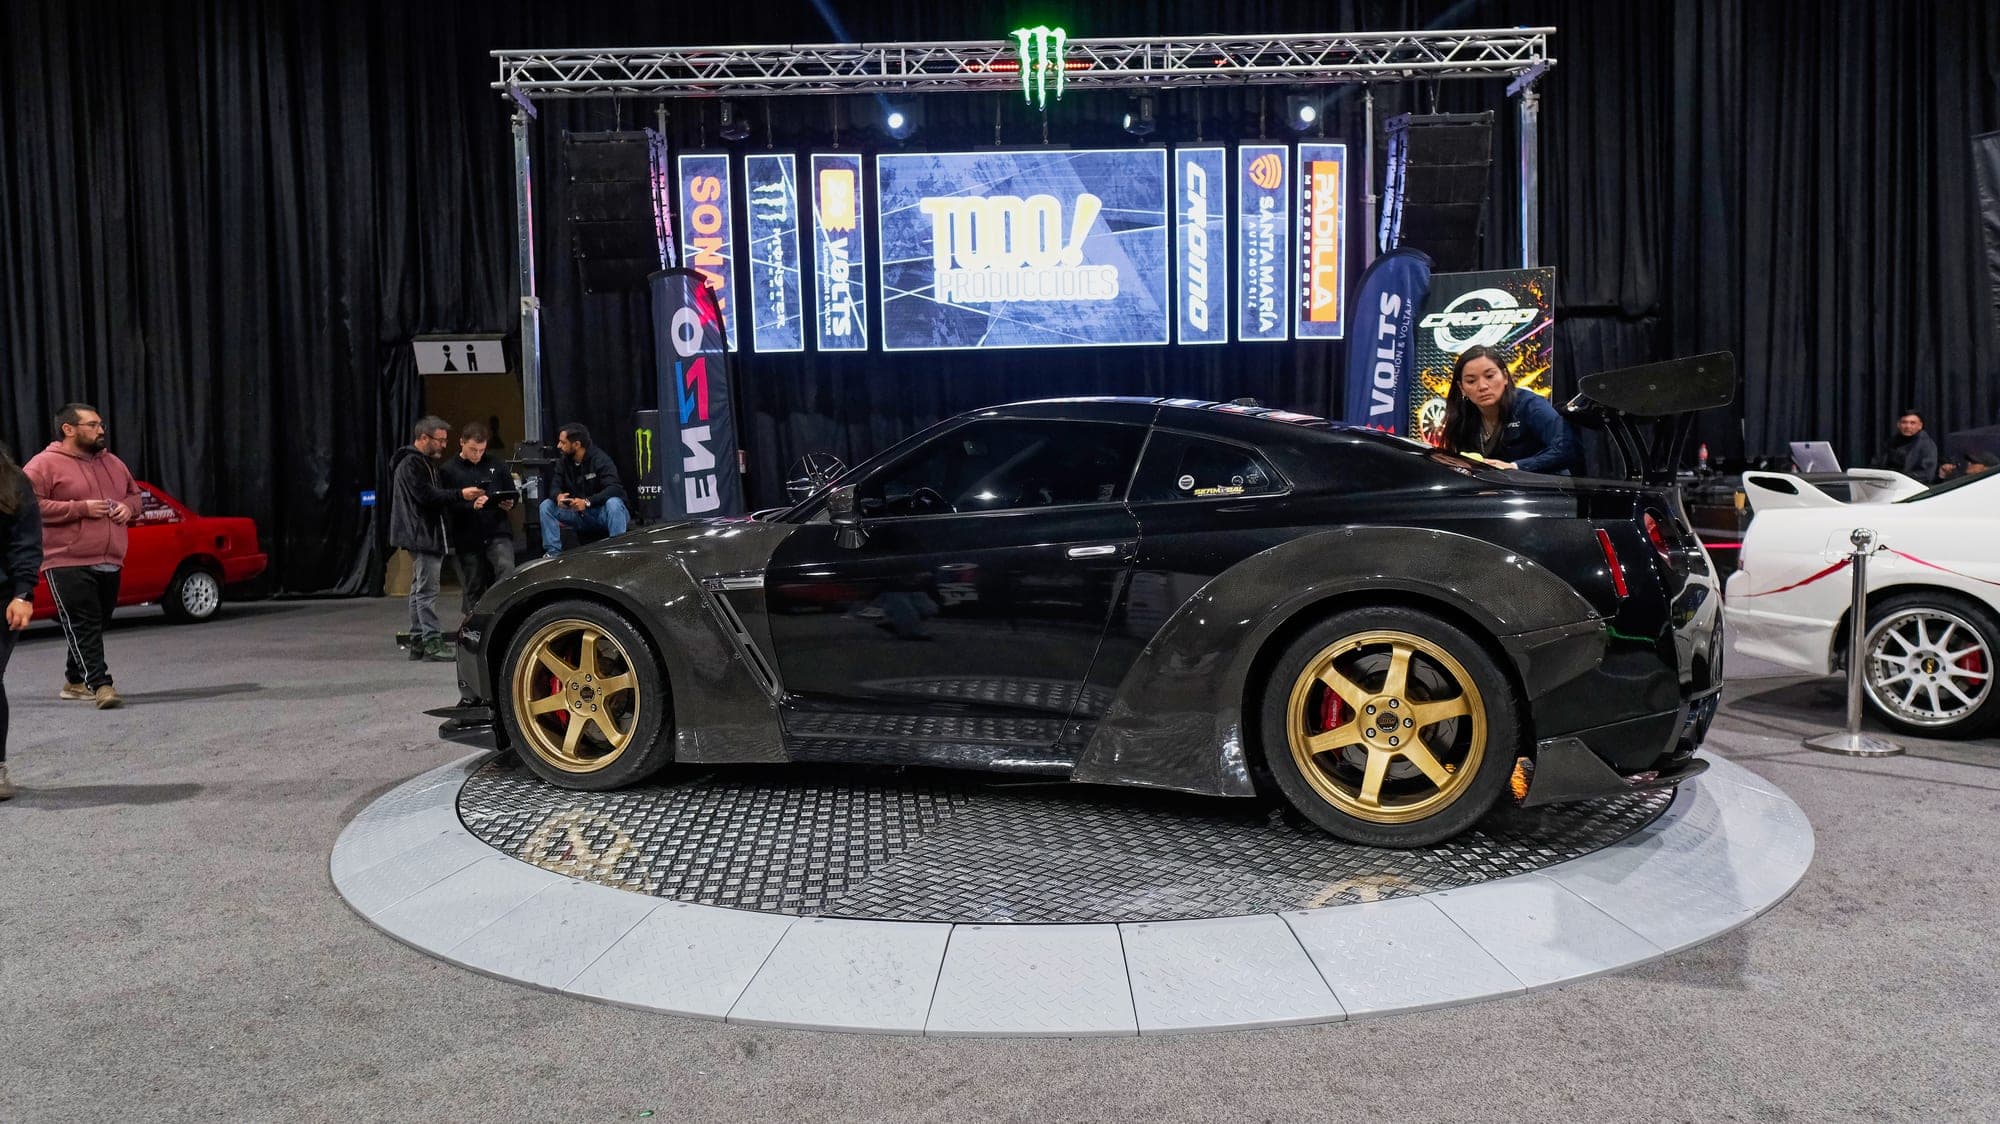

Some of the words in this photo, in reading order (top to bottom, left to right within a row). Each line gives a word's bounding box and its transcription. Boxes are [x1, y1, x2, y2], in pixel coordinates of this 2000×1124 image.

[690, 175, 727, 327] SONA
[772, 227, 786, 329] MONSTER
[831, 237, 851, 336] VOLTS
[937, 267, 1117, 302] PRODUCCIONES
[1187, 161, 1209, 332] CROMO
[1248, 222, 1257, 309] AUTOMOTRIZ
[1303, 174, 1312, 309] MOTORSPORT
[1312, 173, 1336, 310] PADILLA
[1370, 291, 1402, 417] VOLTS
[1419, 308, 1540, 328] CROMO
